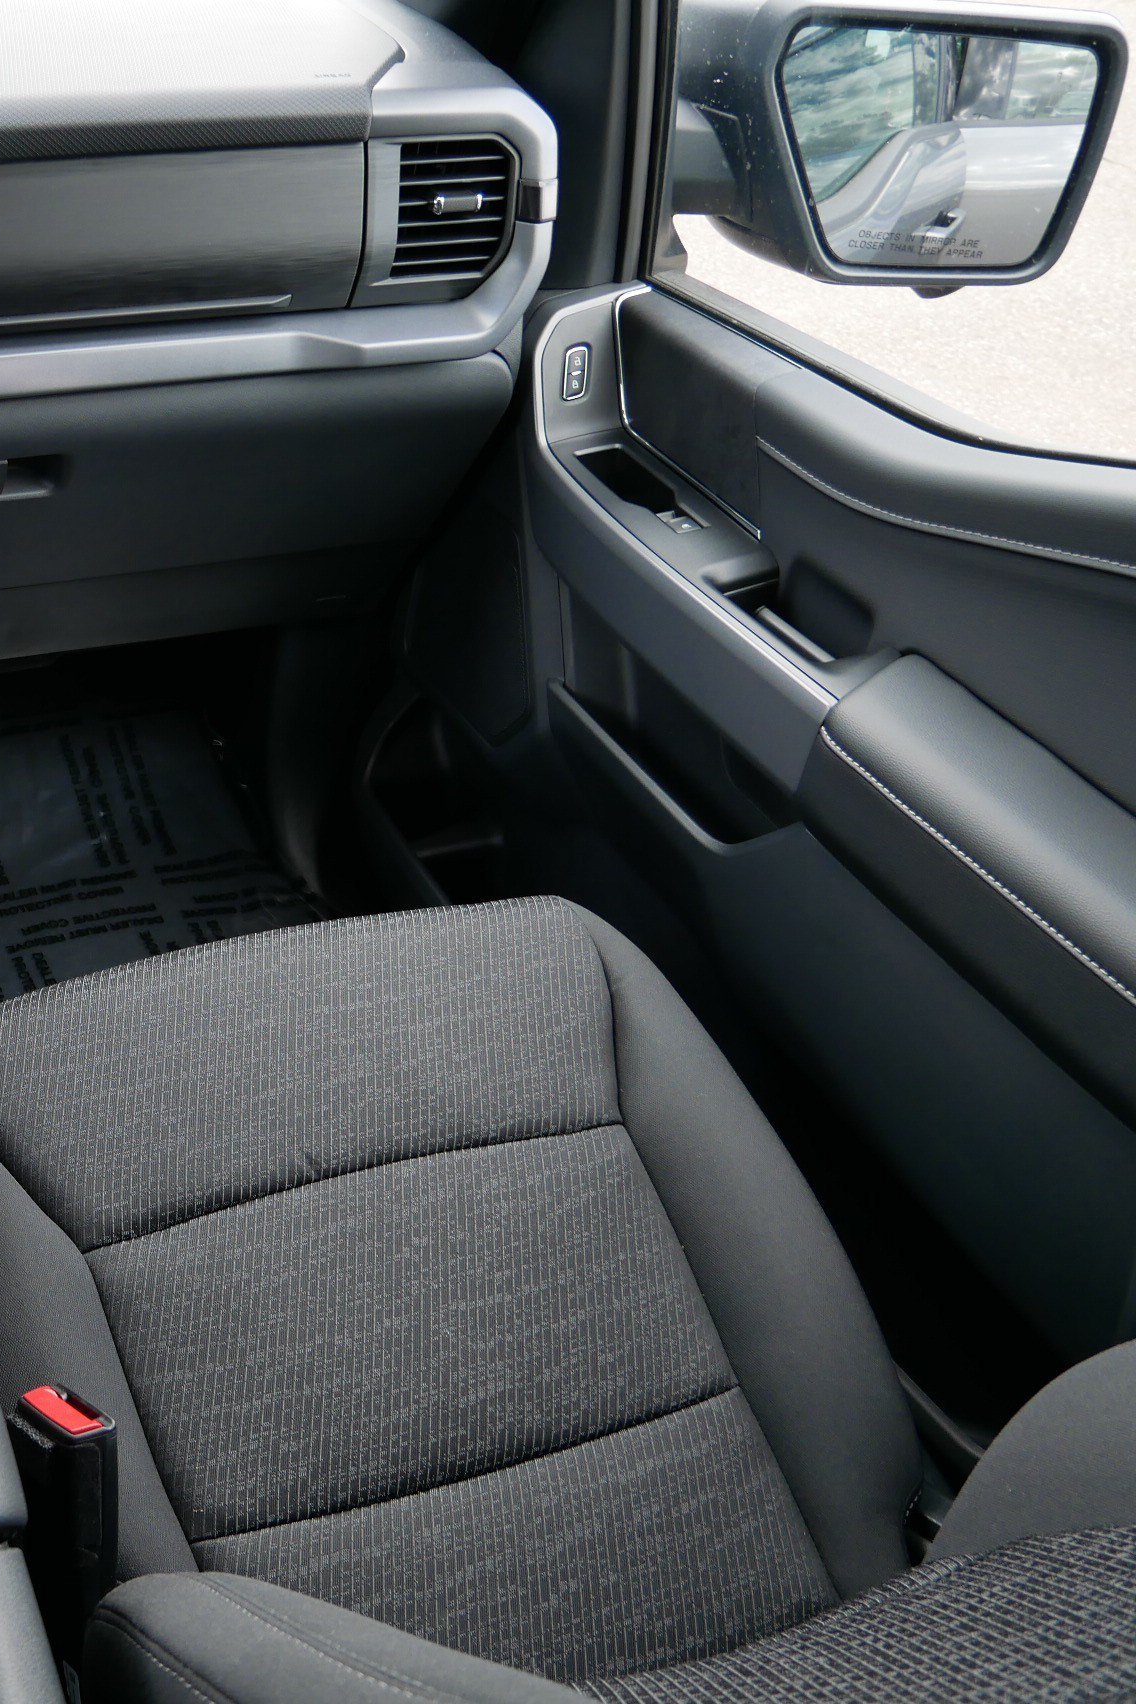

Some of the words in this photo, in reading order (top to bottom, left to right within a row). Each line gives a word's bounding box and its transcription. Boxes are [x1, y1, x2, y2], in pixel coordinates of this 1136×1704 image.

[858, 230, 901, 242] OBJECTS
[922, 236, 956, 246] MIRROR
[960, 240, 980, 248] ARE
[848, 240, 885, 250] CLOSER
[890, 243, 914, 254] THAN
[918, 246, 942, 256] THEY
[946, 249, 984, 260] APPEAR
